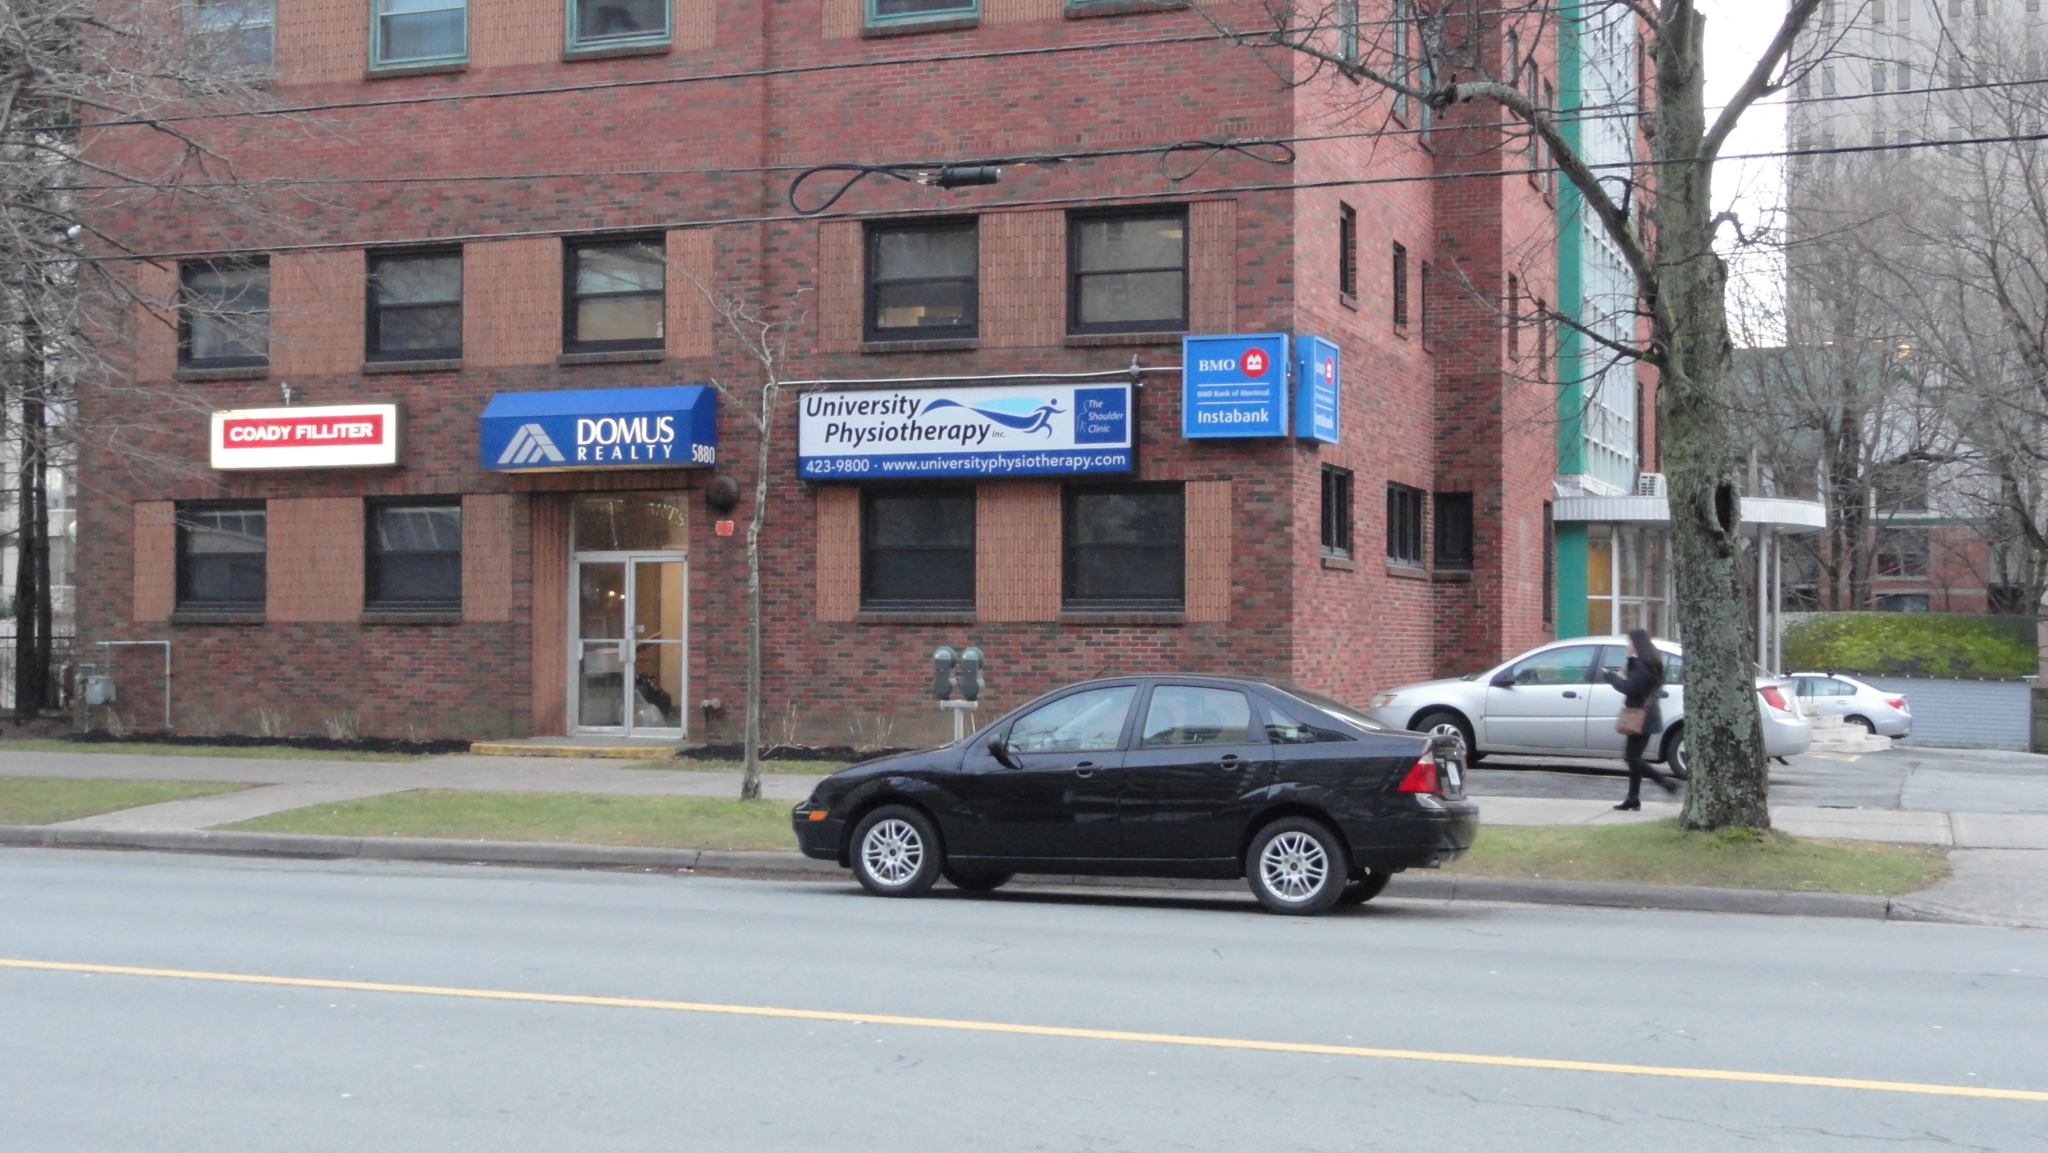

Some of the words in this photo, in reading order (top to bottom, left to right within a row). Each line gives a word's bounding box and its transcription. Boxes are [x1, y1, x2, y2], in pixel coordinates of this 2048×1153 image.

[1198, 359, 1236, 372] BMO
[1197, 390, 1212, 398] BMO
[1213, 389, 1231, 398] Bank
[1231, 389, 1239, 397] of
[1240, 388, 1270, 397] Montreal
[806, 394, 922, 420] University
[1088, 399, 1103, 409] The
[1088, 411, 1124, 422] Shoulder
[1198, 408, 1269, 424] Instabank
[229, 425, 291, 442] COADY
[295, 422, 373, 440] FILLITER
[577, 416, 675, 446] DOMUS
[824, 420, 992, 449] Physiotherapy
[991, 430, 1007, 439] Inc.
[1088, 424, 1111, 434] Clinic
[577, 444, 674, 462] REALTY
[692, 443, 716, 464] 5880
[806, 459, 870, 475] 423-9800
[882, 453, 1126, 473] www.universityphysiotherapy.com
